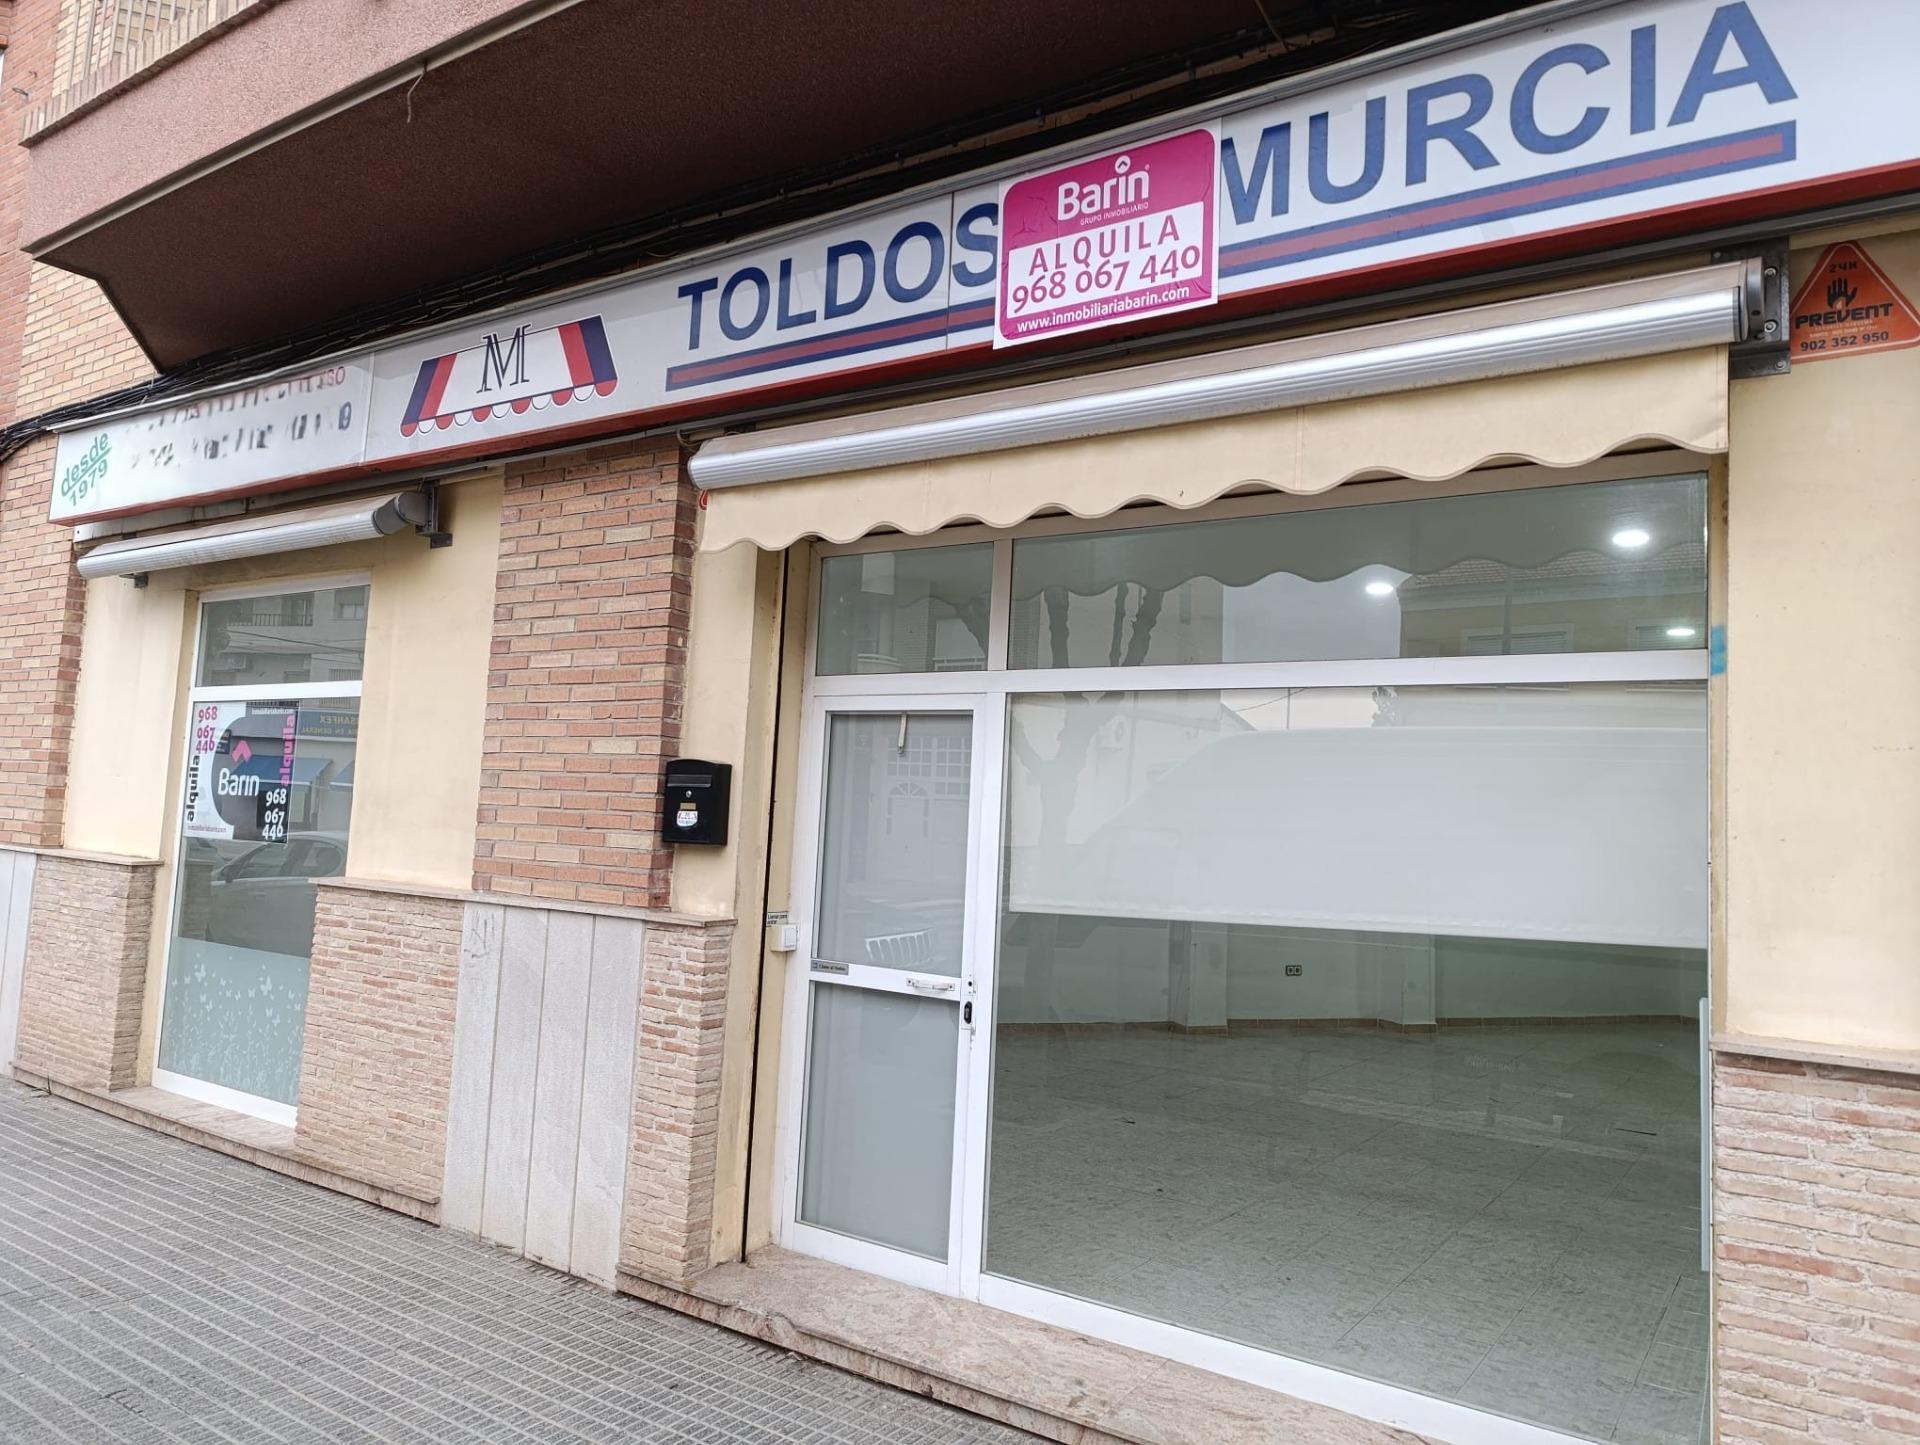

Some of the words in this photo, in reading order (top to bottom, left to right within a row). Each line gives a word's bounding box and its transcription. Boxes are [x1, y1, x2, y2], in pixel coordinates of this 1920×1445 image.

[678, 203, 999, 351] TOLDOS
[1220, 1, 1799, 226] MURCIA
[1057, 155, 1150, 221] Barin
[1079, 213, 1102, 226] GRUPO
[1103, 201, 1149, 219] INMOBILIARIO
[1029, 214, 1180, 277] ALQUILA
[1012, 270, 1067, 314] 968
[1075, 259, 1130, 291] 067
[1139, 244, 1200, 284] 440
[1016, 285, 1190, 333] www.inmobiliariabarin.com
[1795, 303, 1893, 329] PREVENT
[476, 323, 532, 395] M
[1800, 340, 1826, 352] 902
[1832, 335, 1857, 347] 352
[1862, 331, 1889, 344] 950
[61, 433, 109, 497] desde
[69, 459, 108, 507] 1979
[196, 725, 216, 740] 067
[198, 706, 218, 724] 968
[195, 738, 216, 754] 440
[279, 714, 296, 787] alquila
[187, 755, 201, 822] alquila
[217, 768, 260, 797] Barin
[265, 788, 287, 807] 968
[261, 823, 284, 841] 440
[264, 808, 286, 825] 067
